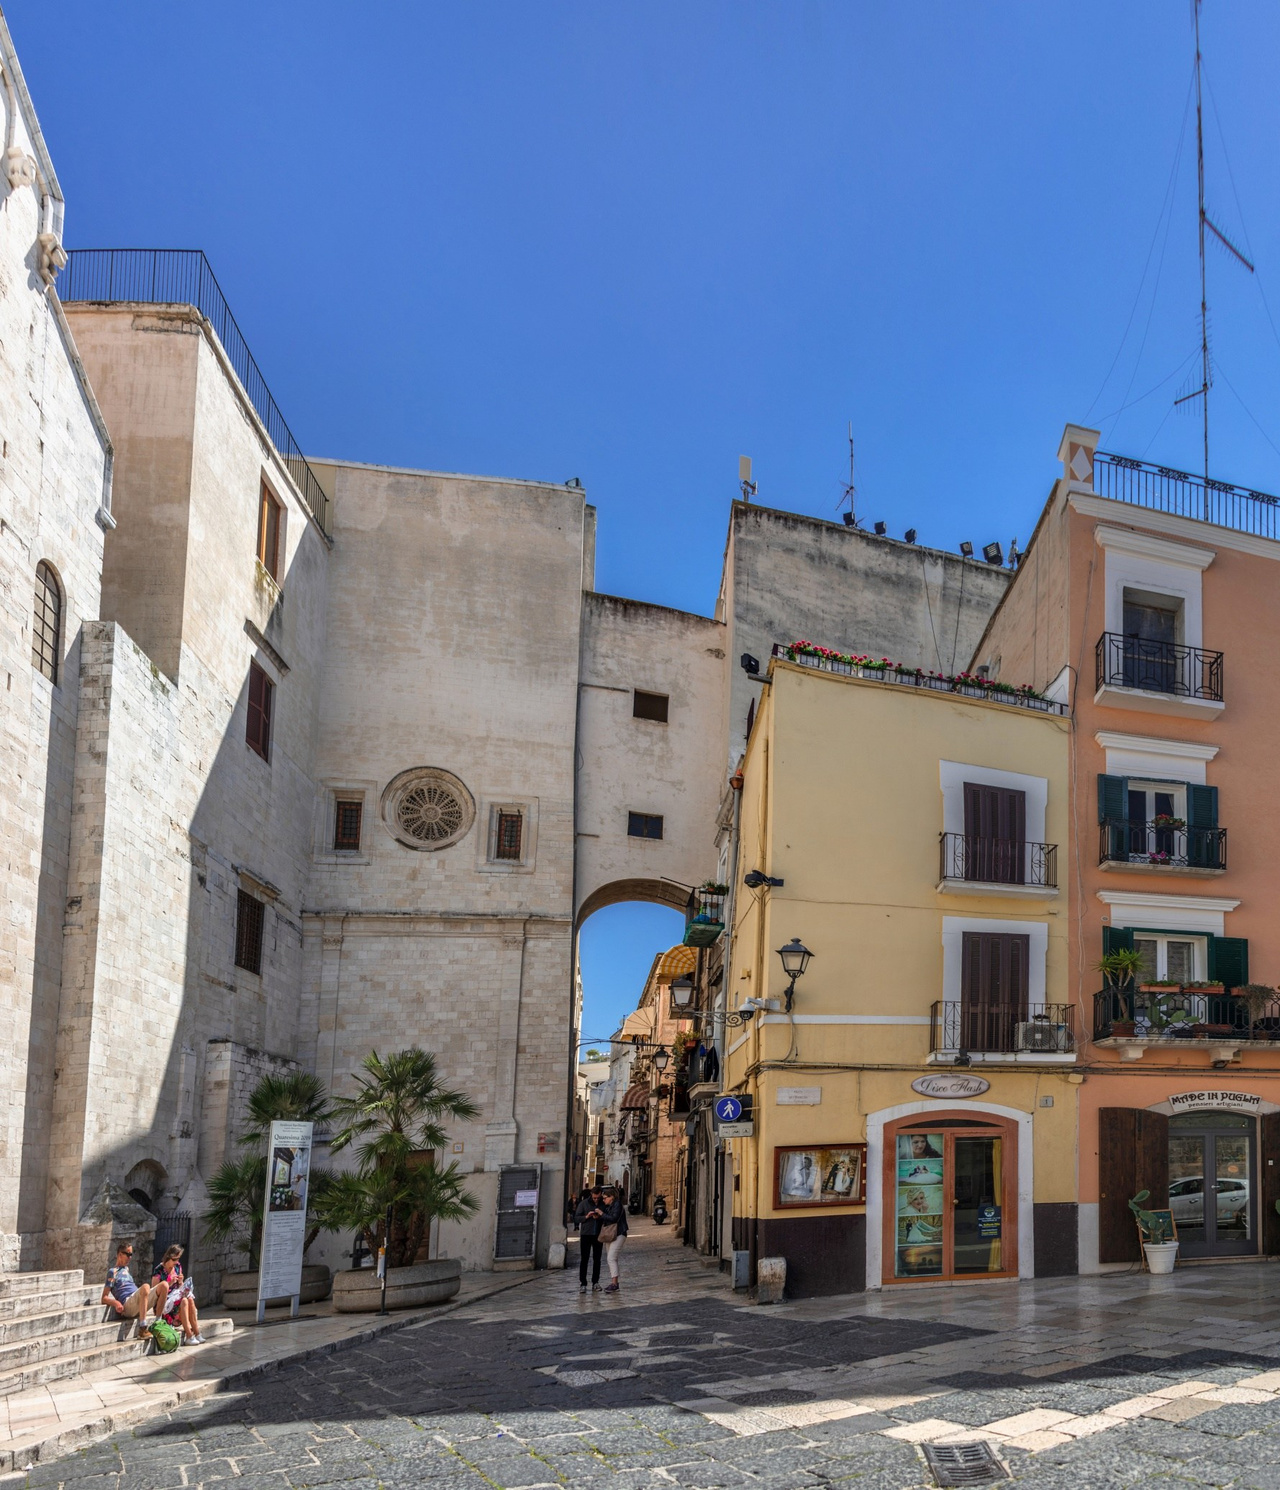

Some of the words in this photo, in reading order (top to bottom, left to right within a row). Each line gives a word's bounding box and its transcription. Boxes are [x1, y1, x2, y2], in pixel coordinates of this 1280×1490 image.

[919, 1079, 948, 1093] Disco
[950, 1079, 982, 1093] Flash
[1171, 1092, 1206, 1105] MADE
[1207, 1092, 1218, 1100] IN
[1220, 1092, 1260, 1104] PUGLIA
